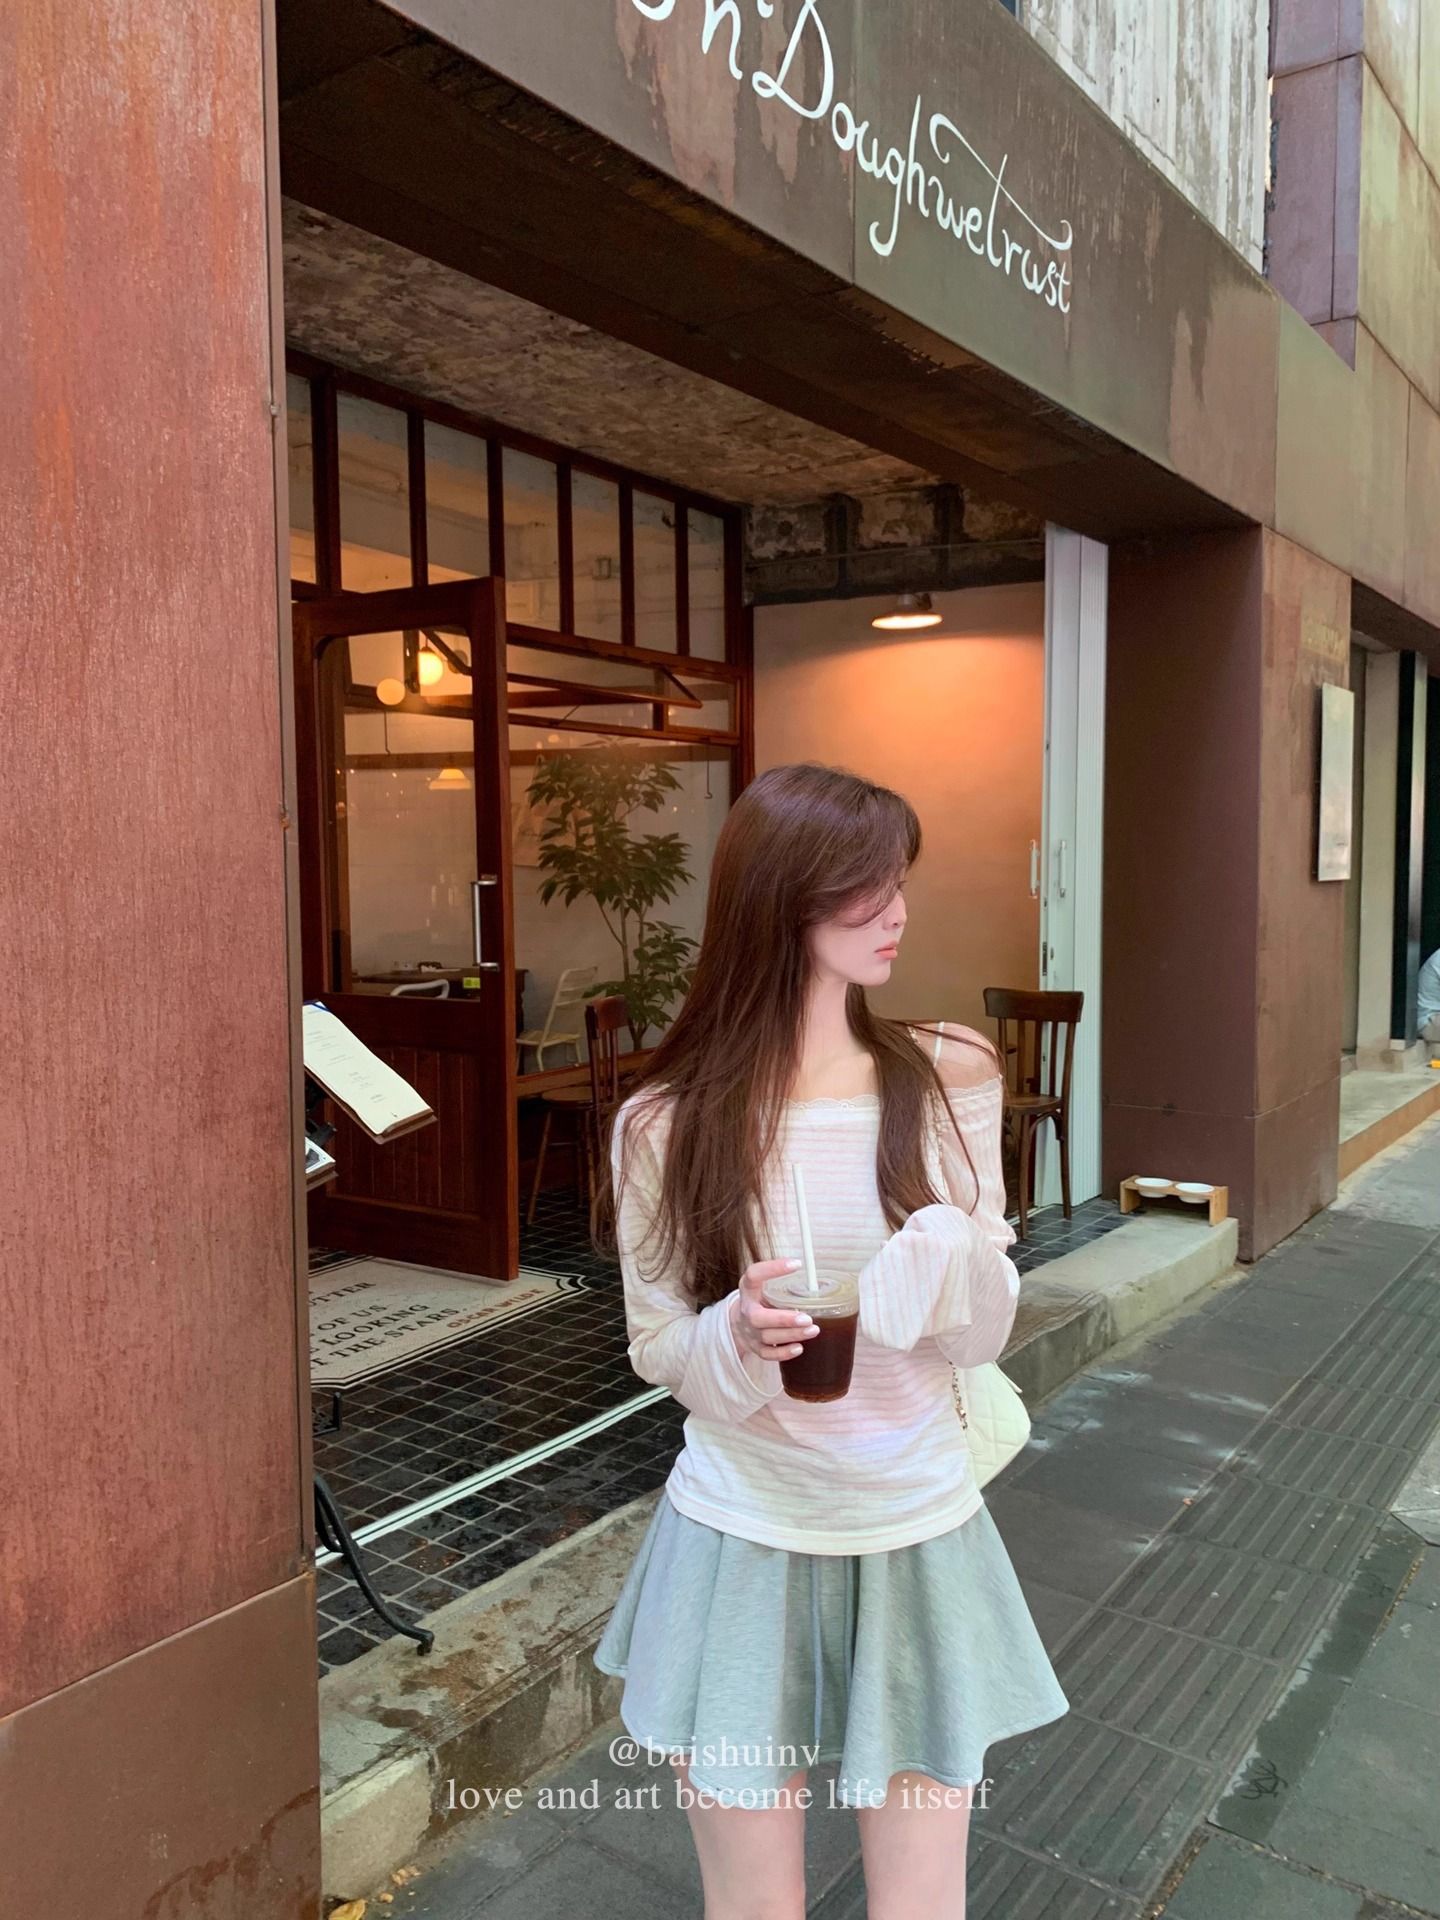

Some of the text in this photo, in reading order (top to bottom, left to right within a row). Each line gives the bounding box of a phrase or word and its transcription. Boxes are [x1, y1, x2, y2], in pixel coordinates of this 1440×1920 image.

[317, 1305, 387, 1331] OF US
[319, 1304, 430, 1346] LOOKING
[446, 1307, 495, 1329] OSCAR
[329, 1338, 386, 1358] THE
